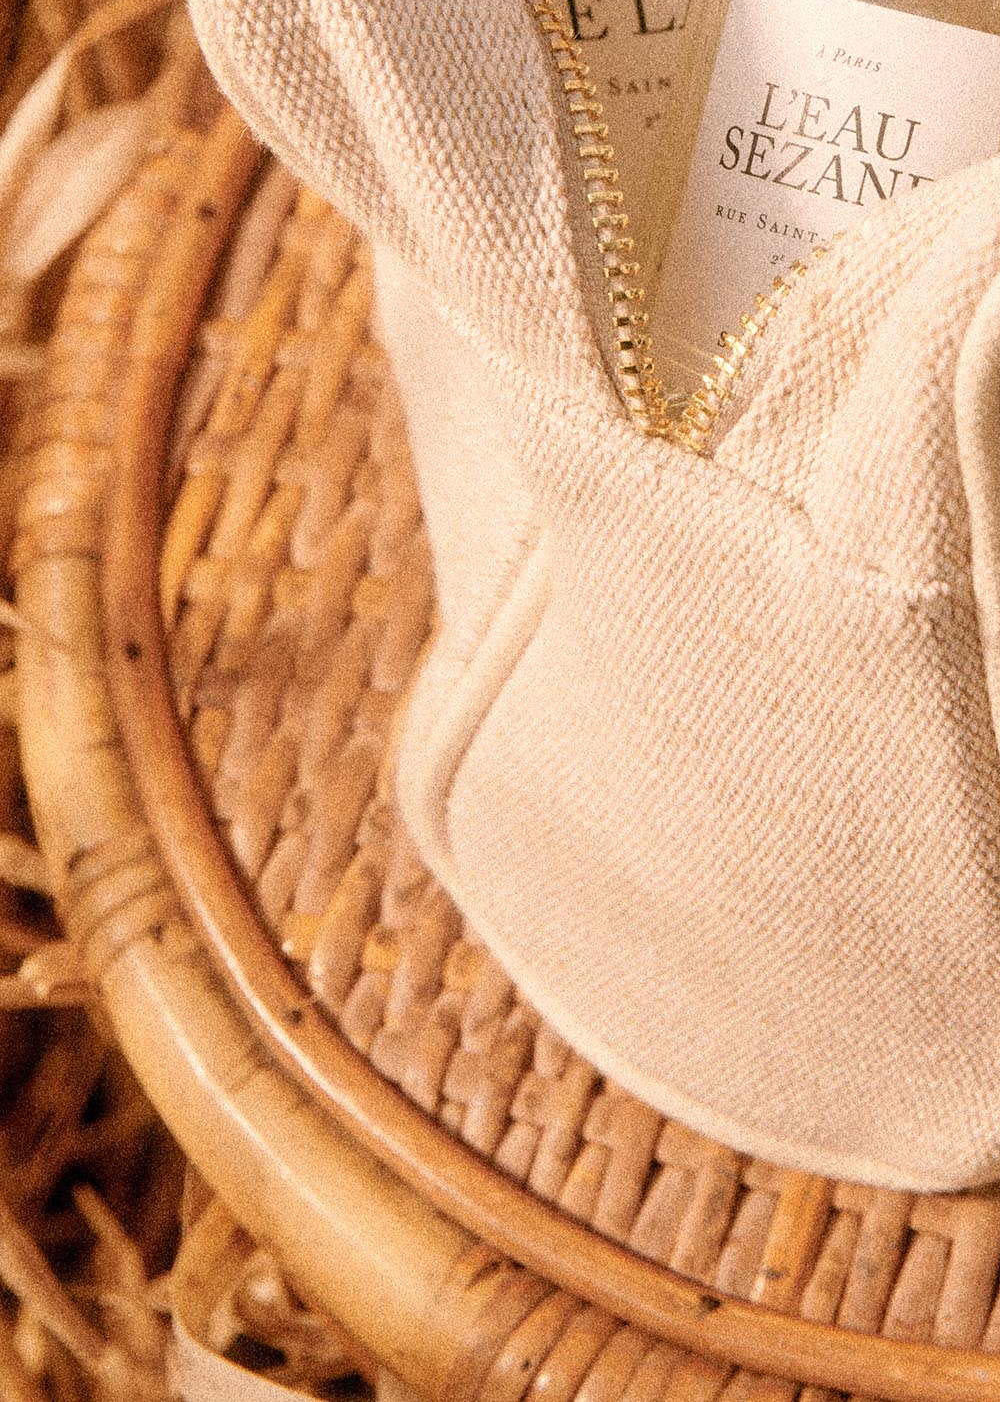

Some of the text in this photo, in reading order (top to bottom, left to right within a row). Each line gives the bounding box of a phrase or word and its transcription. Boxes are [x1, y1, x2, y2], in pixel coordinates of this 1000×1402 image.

[832, 47, 882, 73] PARIS
[756, 82, 921, 161] L'EAU
[715, 204, 747, 224] RUE
